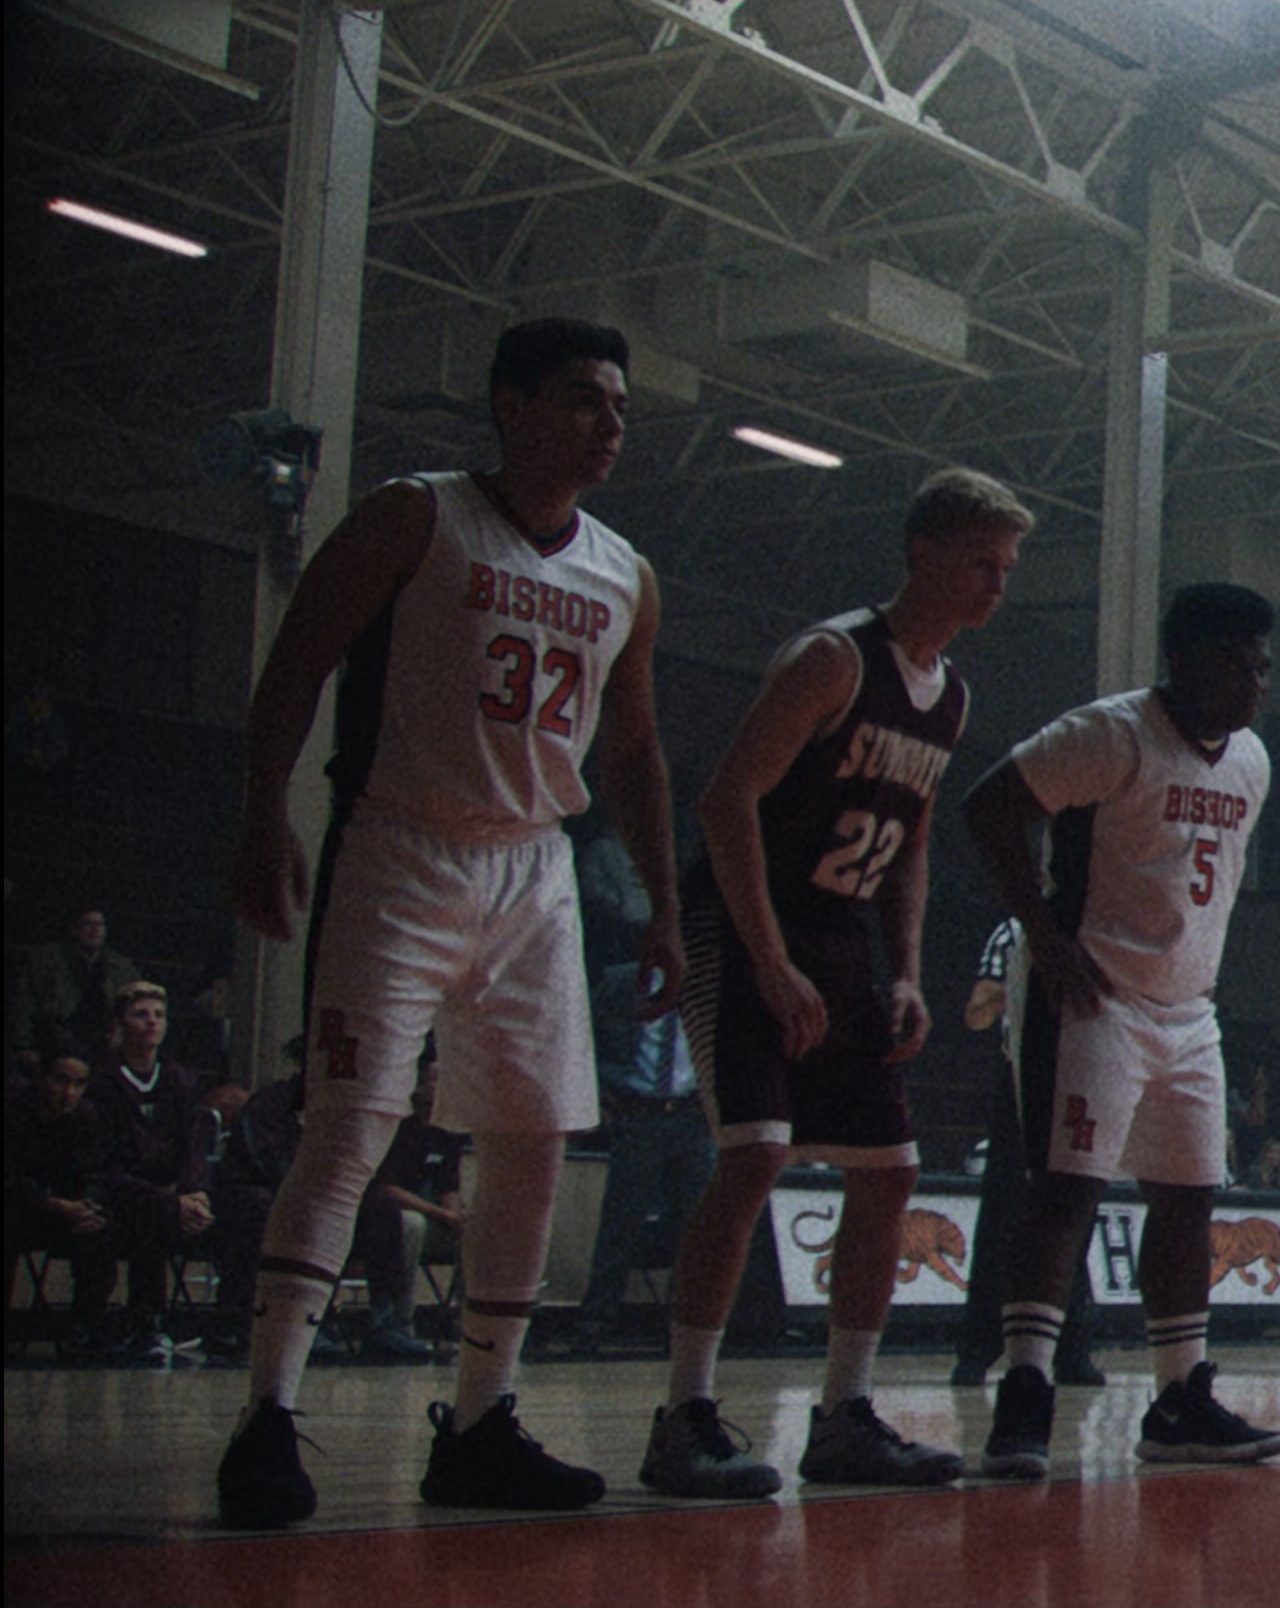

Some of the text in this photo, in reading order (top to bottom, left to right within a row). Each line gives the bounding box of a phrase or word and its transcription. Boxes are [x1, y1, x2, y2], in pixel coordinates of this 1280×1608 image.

[467, 561, 611, 645] BISHOP
[480, 634, 584, 738] 32
[1163, 783, 1248, 832] BISHOP
[809, 809, 906, 900] 22
[1190, 838, 1219, 906] 5
